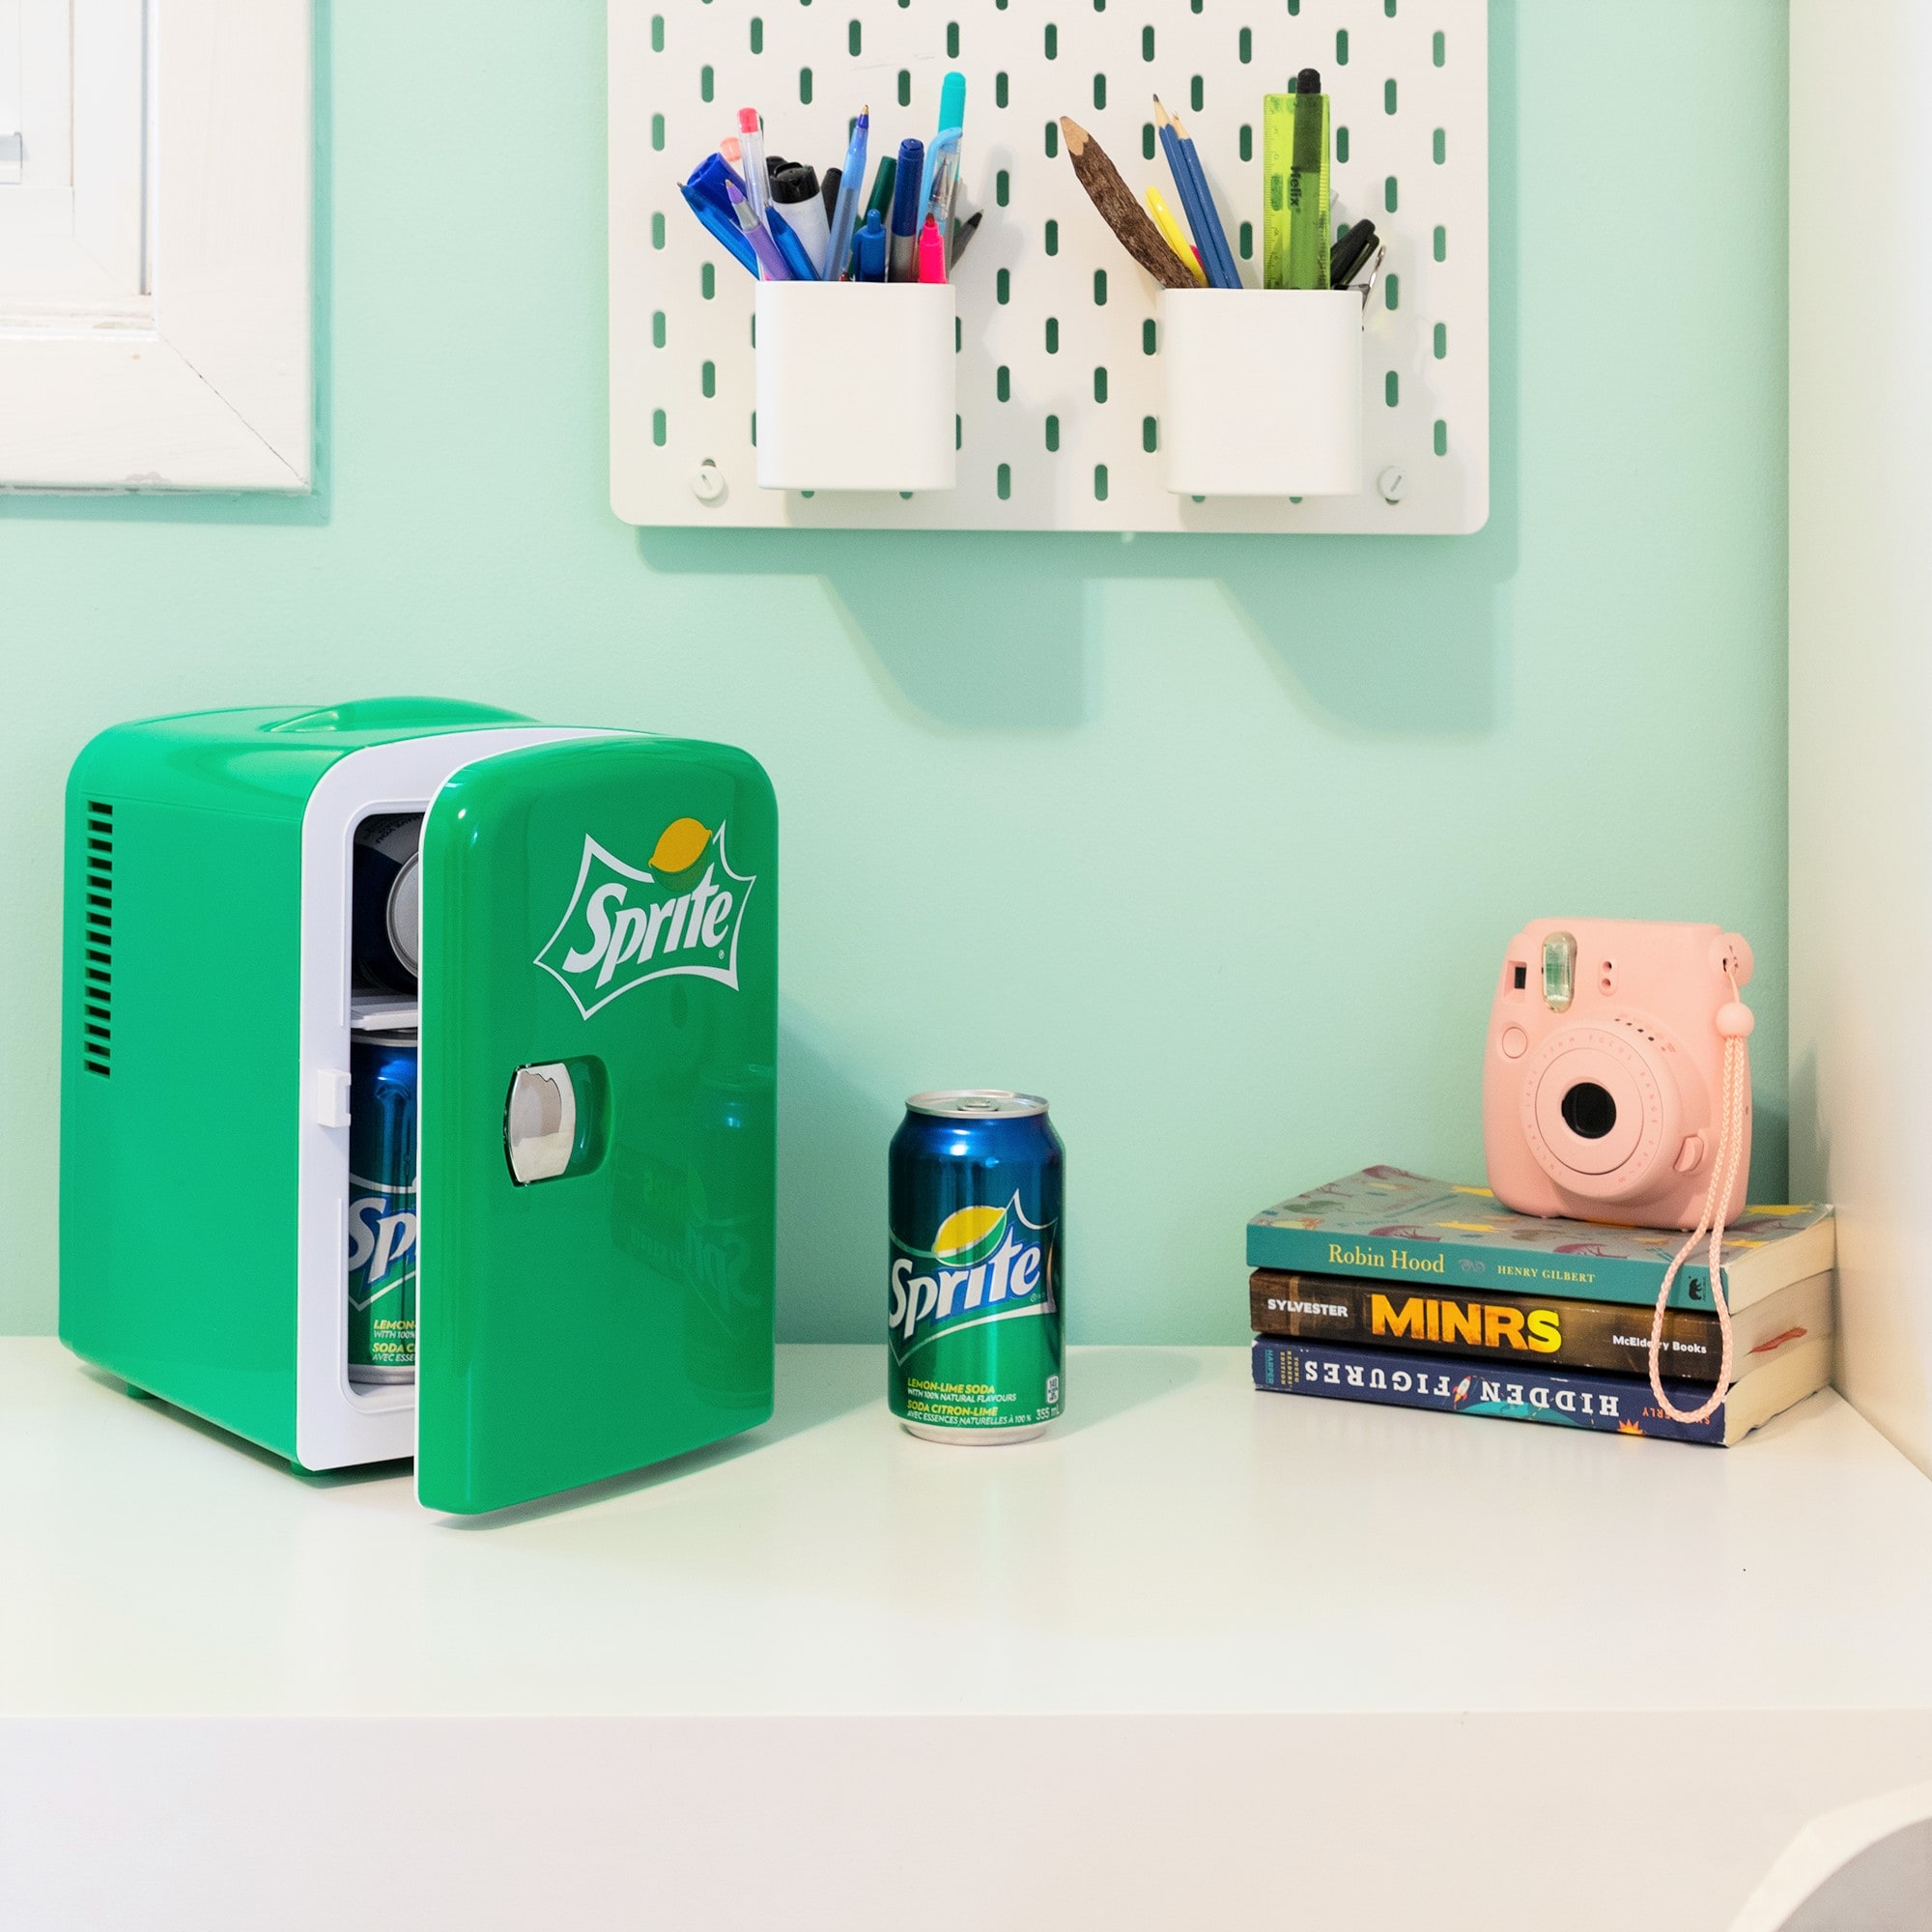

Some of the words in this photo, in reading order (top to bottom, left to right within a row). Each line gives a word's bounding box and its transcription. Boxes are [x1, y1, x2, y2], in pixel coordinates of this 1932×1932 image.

[1290, 166, 1301, 207] Helix
[562, 863, 733, 989] Sprite
[1328, 1244, 1384, 1267] Robin
[1391, 1249, 1445, 1273] Hood
[890, 1226, 1041, 1340] Sprite
[1497, 1264, 1539, 1278] HENRY
[1542, 1268, 1596, 1284] GILBERT
[1266, 1298, 1349, 1318] SYLVESTER
[1370, 1293, 1563, 1353] MINRS
[373, 1330, 396, 1339] WITH
[372, 1342, 404, 1353] SODA
[1672, 1341, 1707, 1354] Books
[1265, 1350, 1274, 1384] HARPER
[907, 1378, 965, 1393] LEMON-LIME
[965, 1384, 995, 1394] SODA
[1305, 1360, 1451, 1397] FIGURES
[907, 1389, 923, 1398] WITH
[923, 1391, 939, 1400] 100%
[940, 1393, 976, 1403] NATURAL
[977, 1393, 1017, 1403] FLAVOURS
[1480, 1380, 1619, 1417] HIDDEN
[907, 1400, 929, 1411] SODA
[931, 1405, 999, 1416] CITRON-LIME
[907, 1410, 923, 1419] AVEC
[923, 1413, 958, 1425] ESSENCES
[959, 1415, 1007, 1426] NATURELLES
[1008, 1413, 1014, 1423] À
[1036, 1408, 1049, 1421] 355
